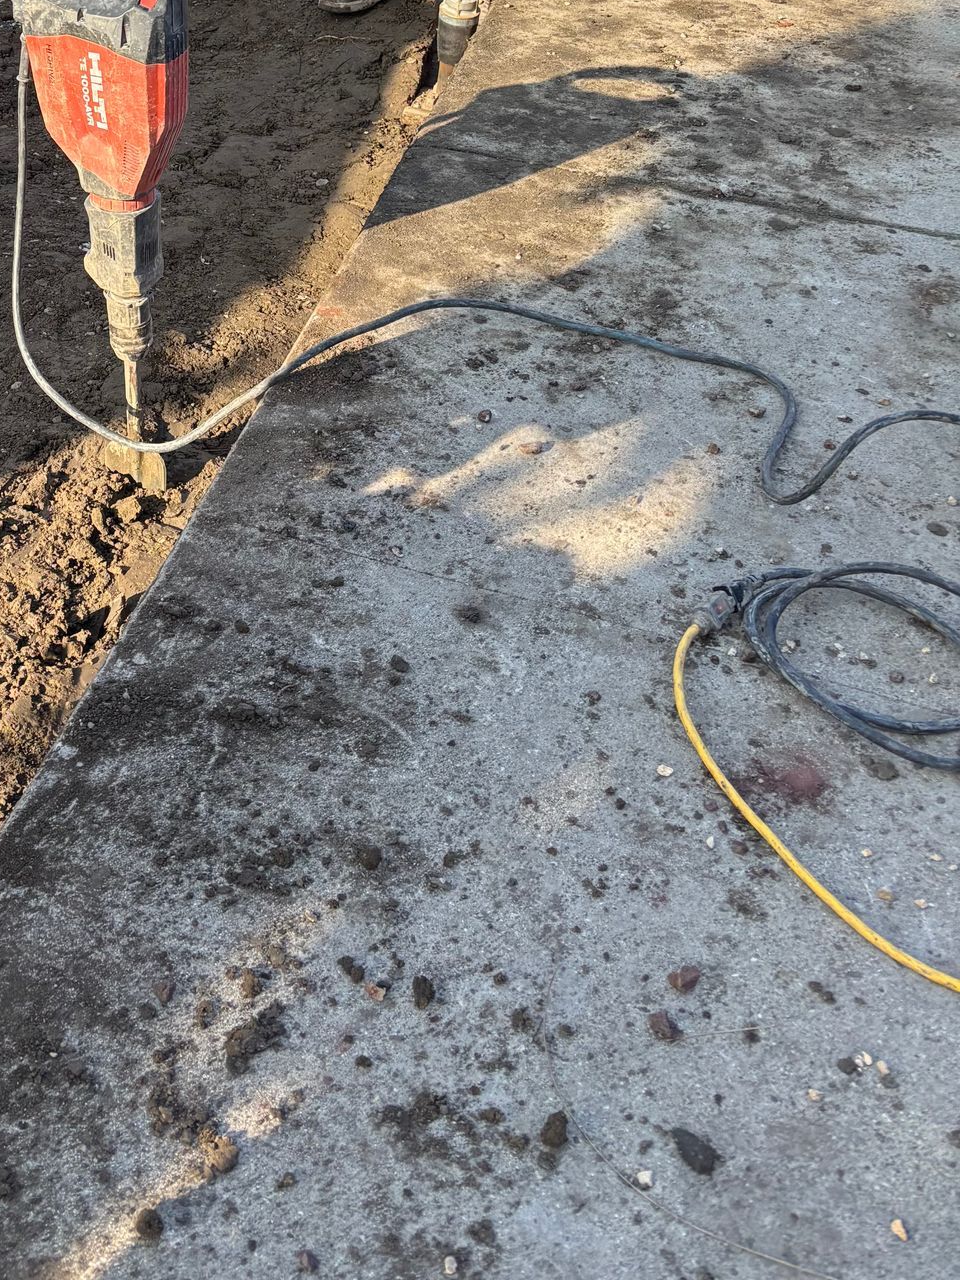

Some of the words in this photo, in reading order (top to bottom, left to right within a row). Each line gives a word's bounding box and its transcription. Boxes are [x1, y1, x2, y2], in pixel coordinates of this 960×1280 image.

[79, 56, 87, 71] TE
[88, 51, 109, 130] HILTI
[81, 73, 95, 127] 1000-AVR
